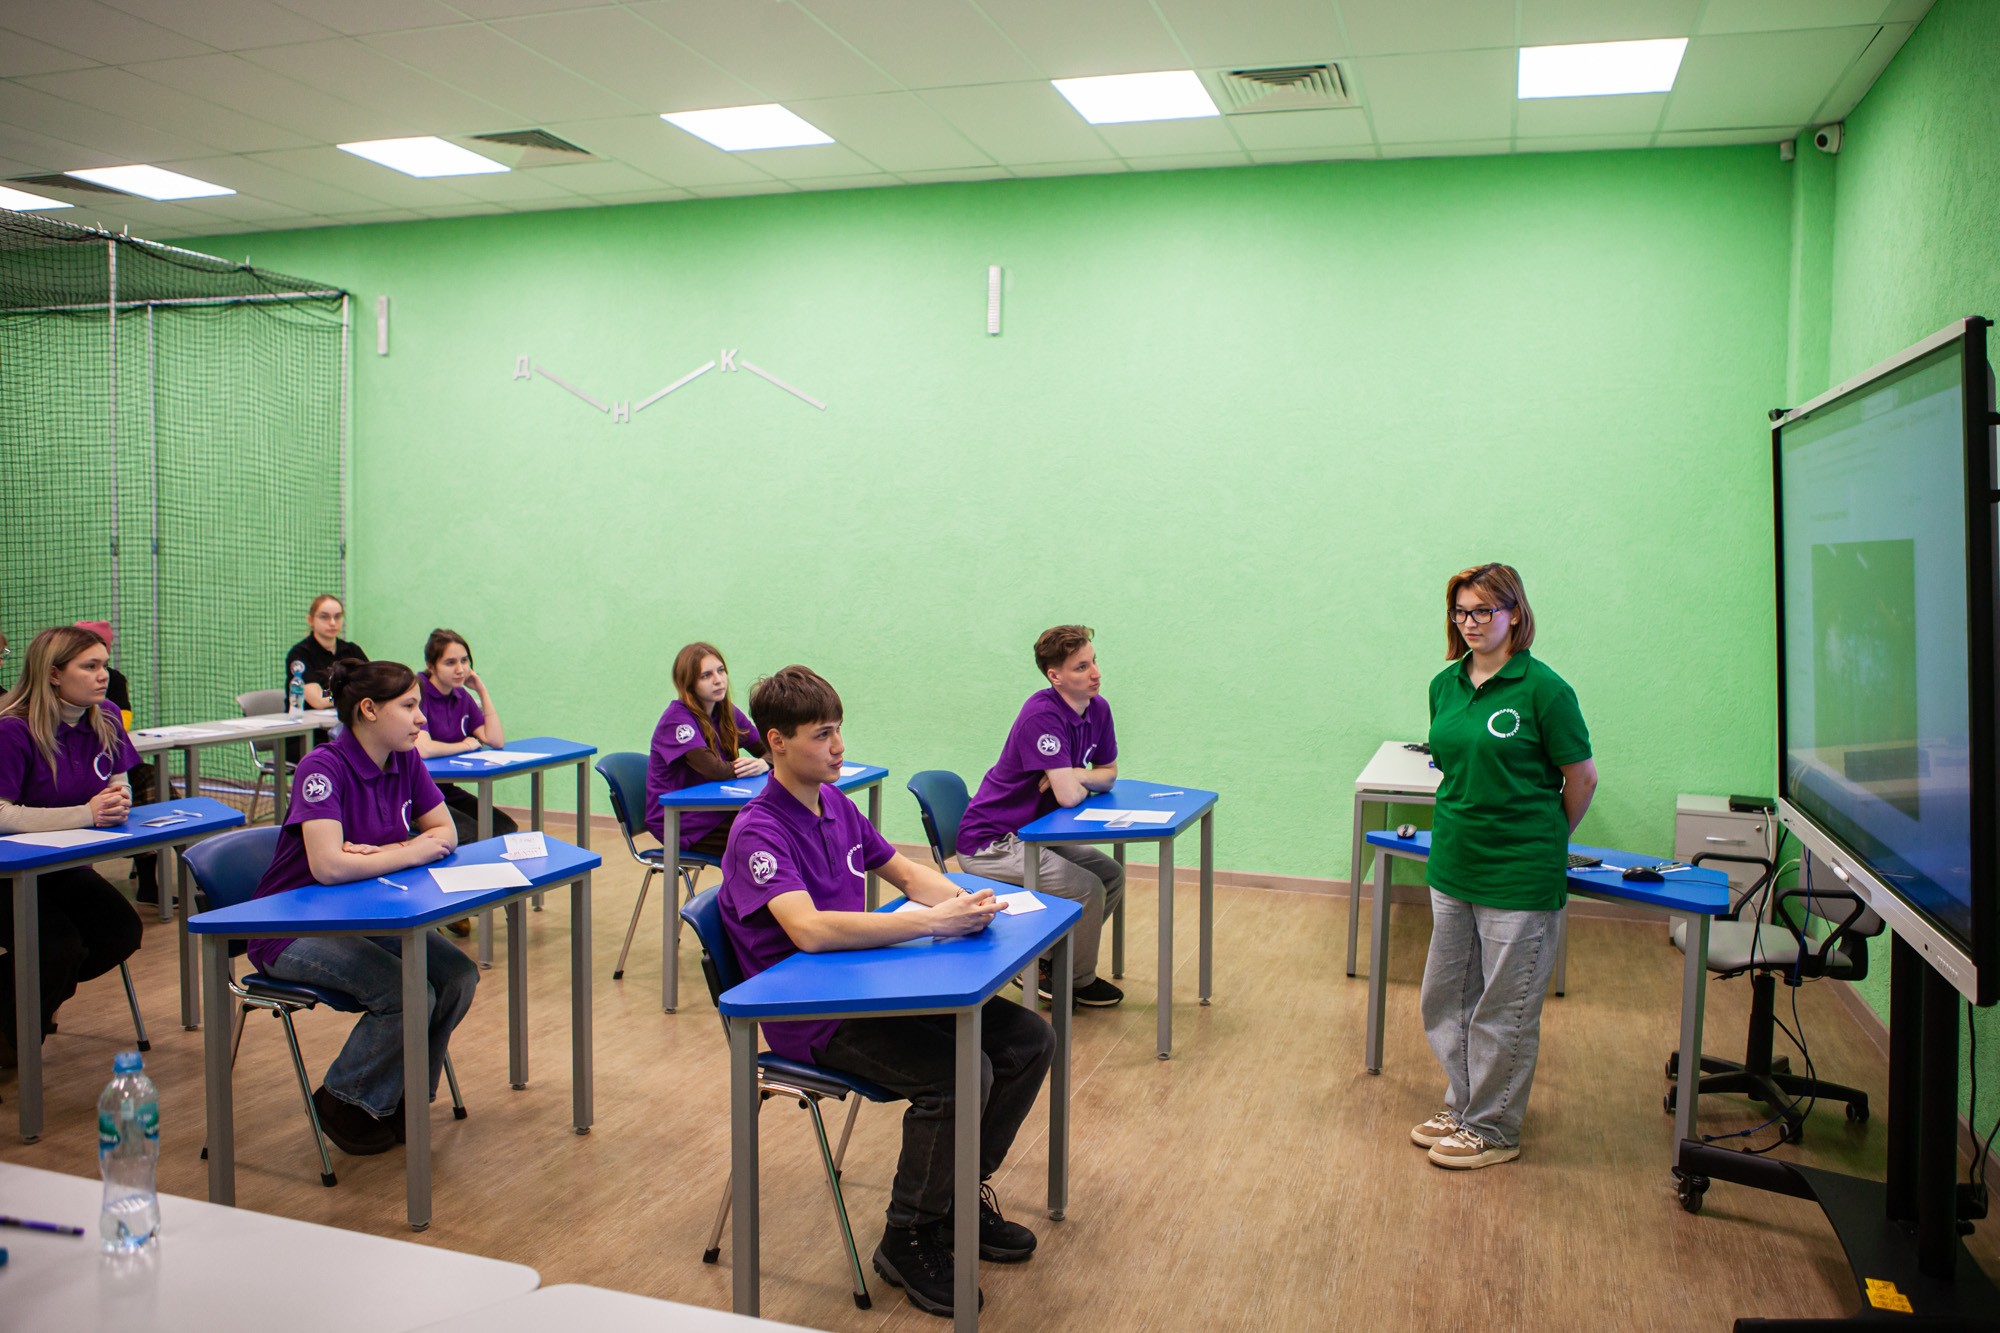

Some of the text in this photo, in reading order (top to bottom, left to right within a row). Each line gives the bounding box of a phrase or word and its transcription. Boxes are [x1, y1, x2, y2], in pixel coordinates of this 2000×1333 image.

[513, 348, 738, 423] Д Н К
